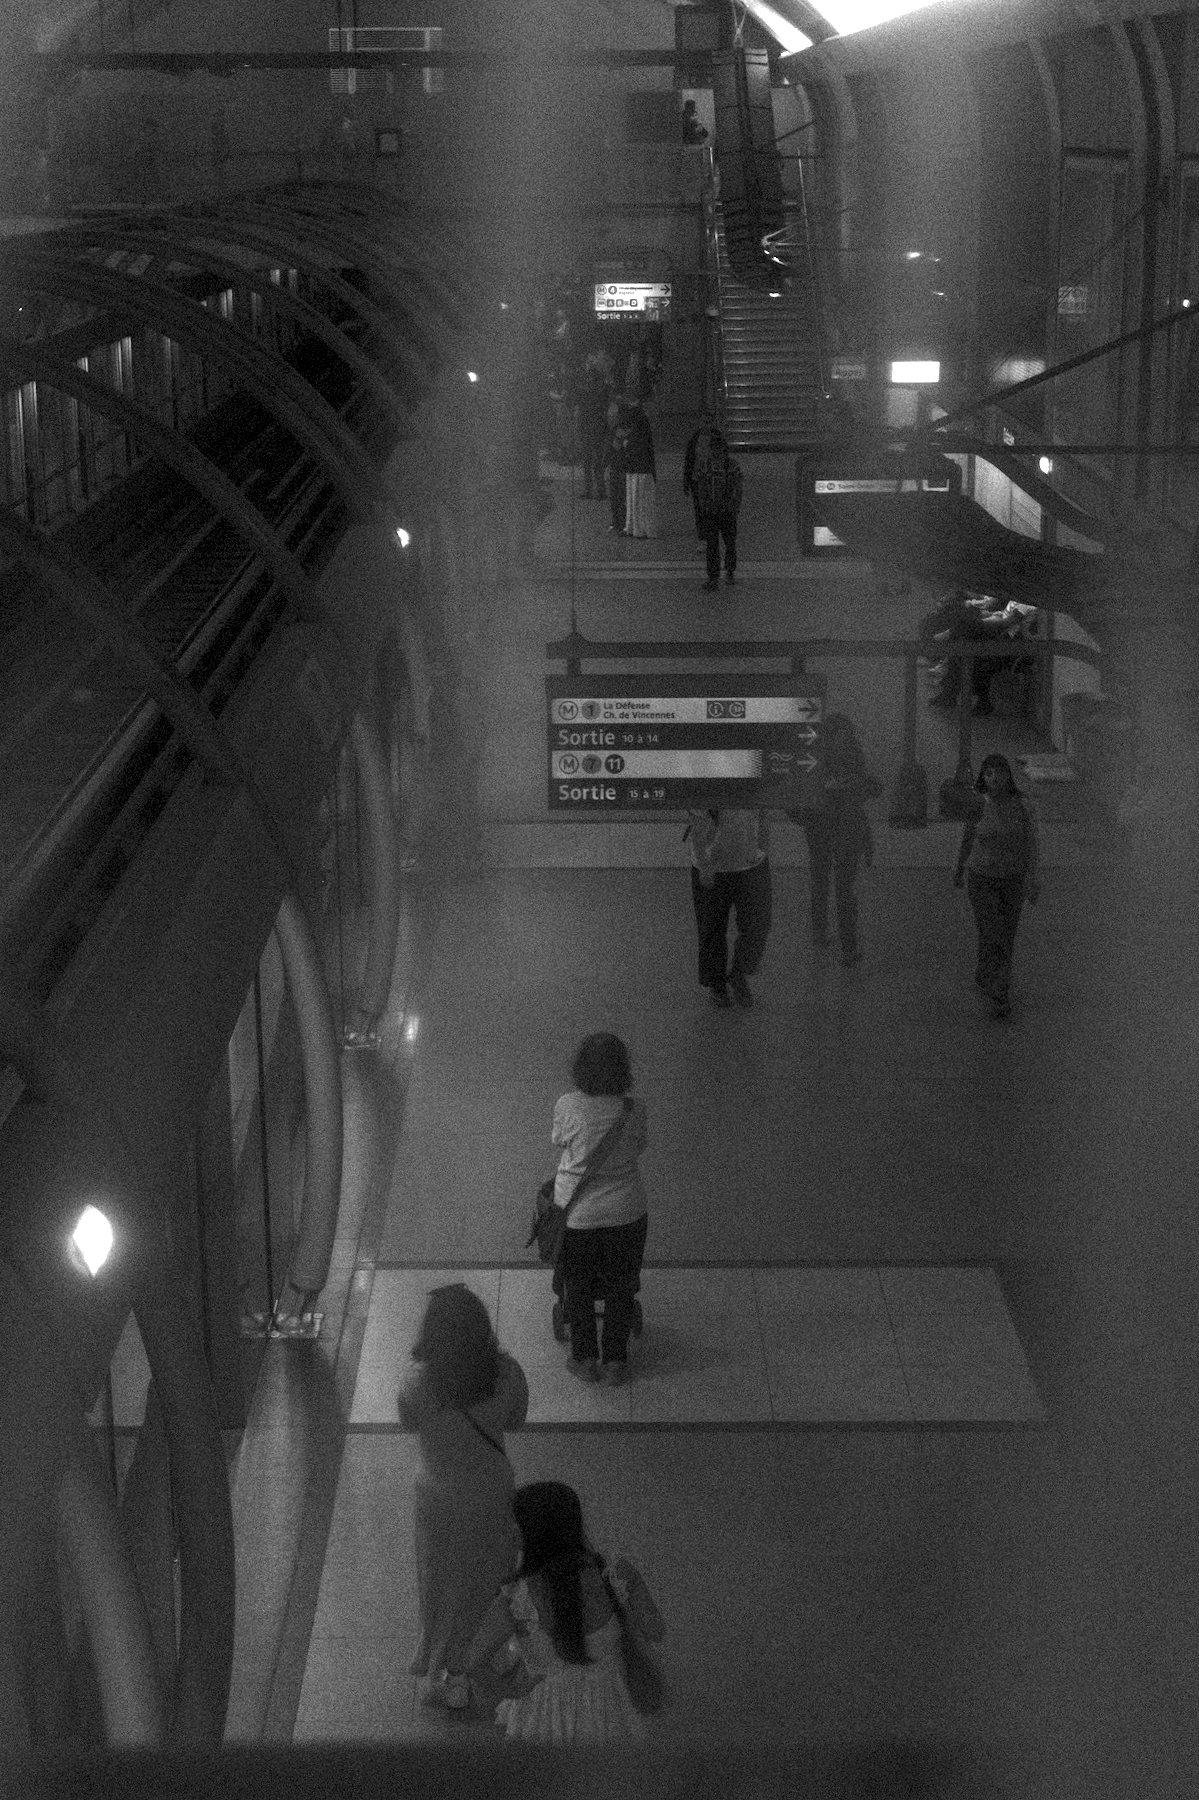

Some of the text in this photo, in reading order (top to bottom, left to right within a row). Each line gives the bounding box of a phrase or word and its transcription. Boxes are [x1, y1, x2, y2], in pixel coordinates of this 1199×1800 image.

[597, 312, 621, 321] Sortie
[603, 701, 651, 710] La Défense
[603, 711, 675, 719] Ch. de Vincennes
[558, 729, 659, 745] Sortie 10 à 14
[607, 758, 621, 770] 11
[558, 784, 665, 800] Sortie 15 à 19
